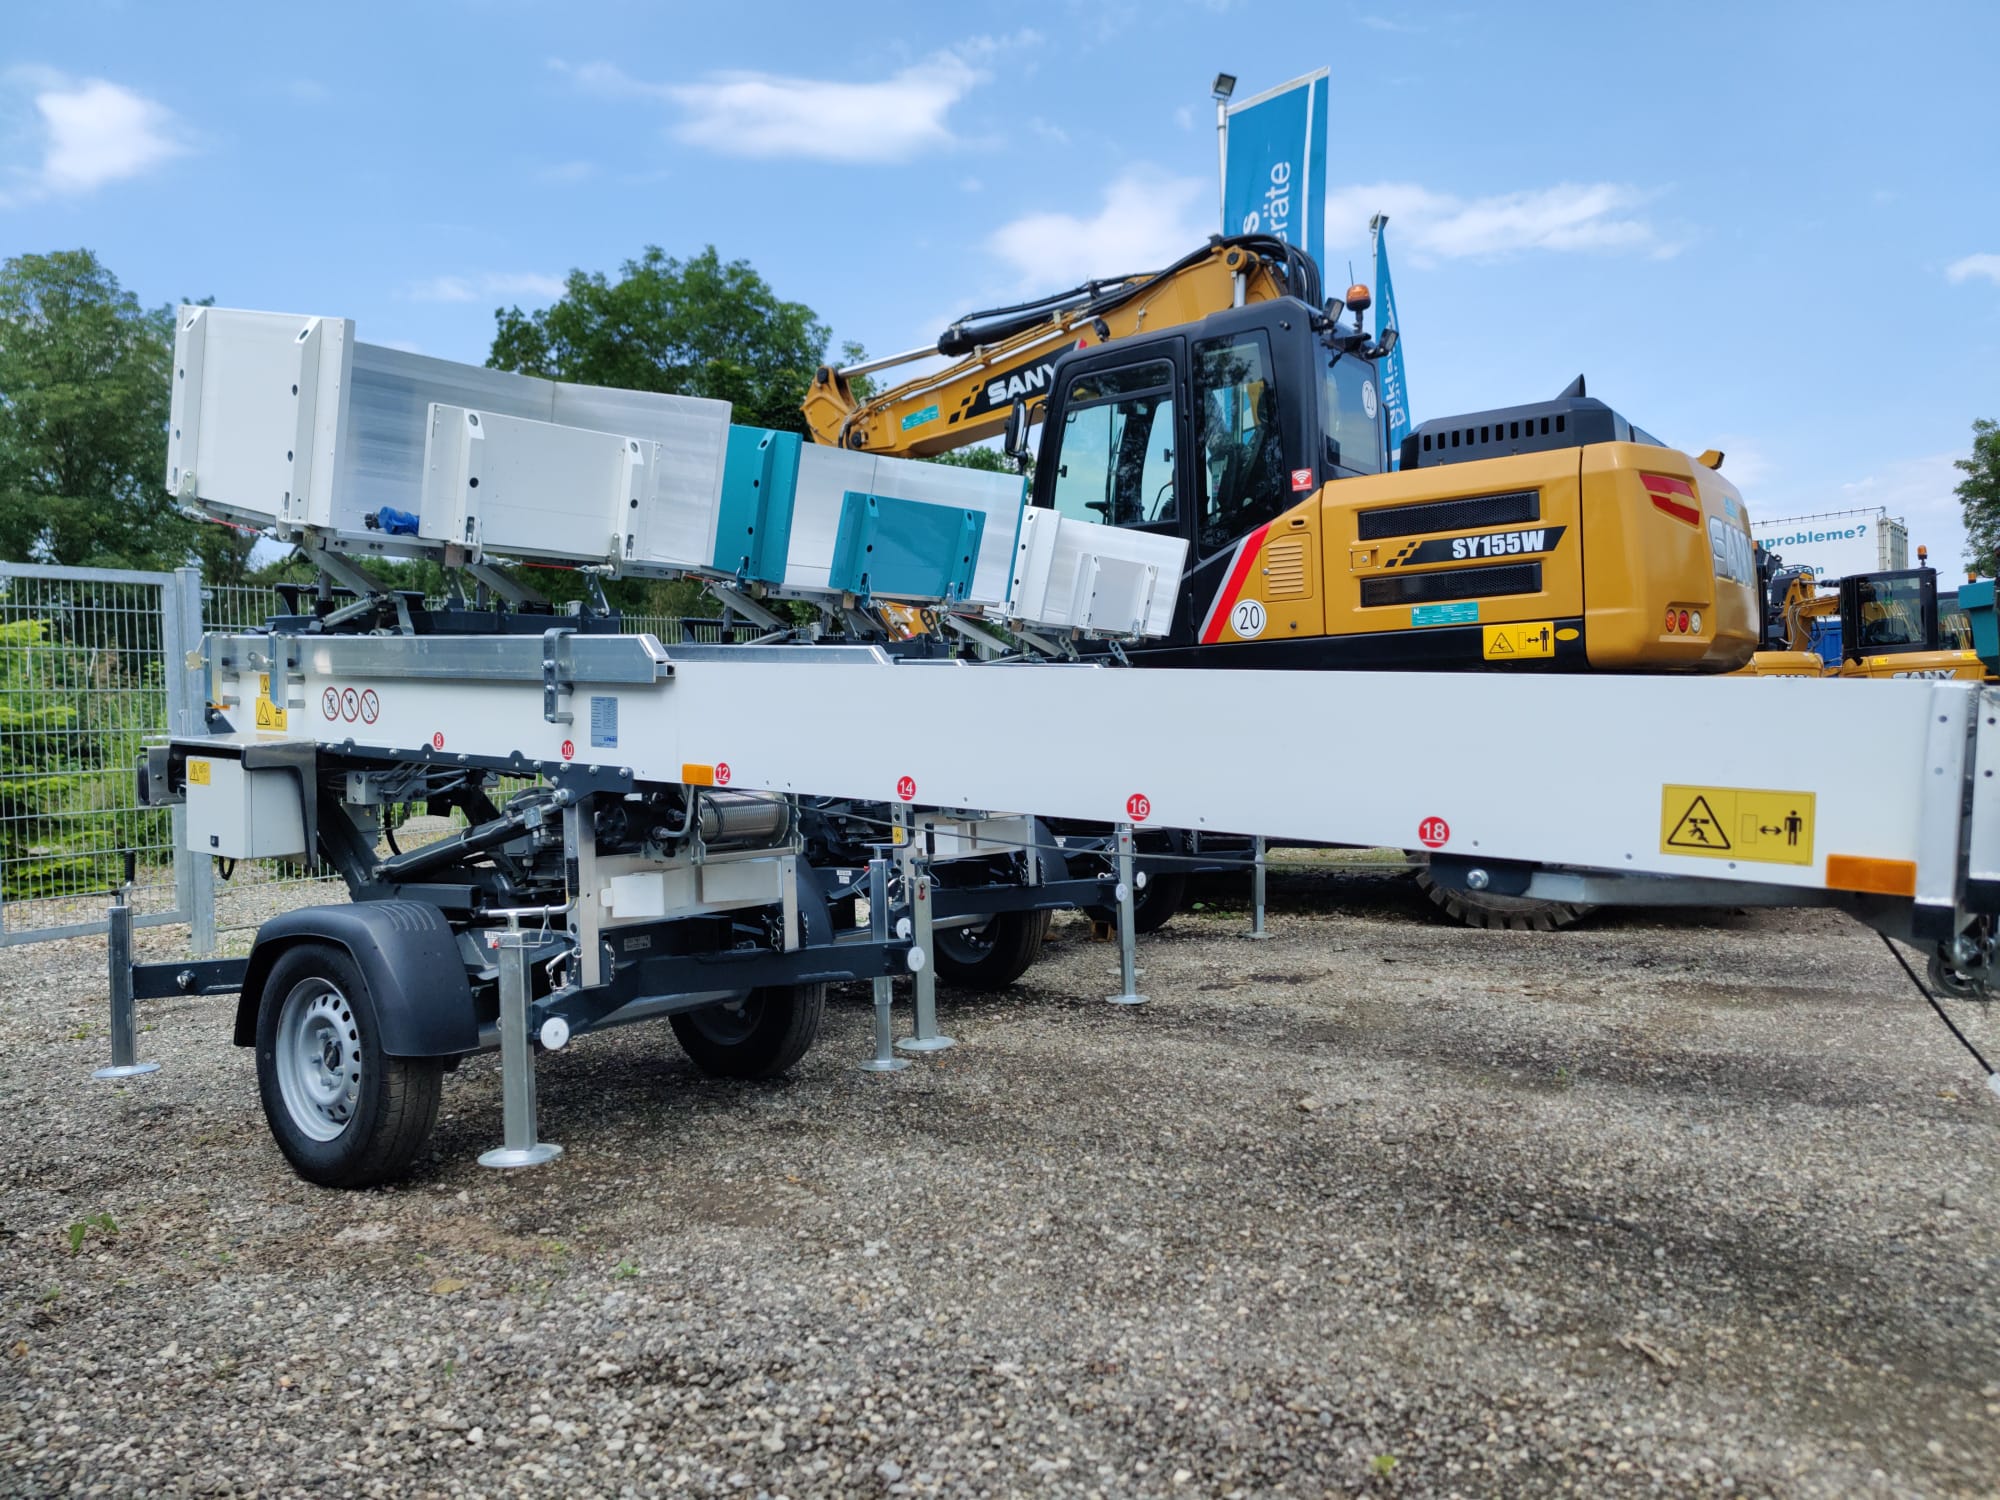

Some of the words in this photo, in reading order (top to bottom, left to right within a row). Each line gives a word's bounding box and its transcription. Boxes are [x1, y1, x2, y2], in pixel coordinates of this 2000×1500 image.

[1452, 530, 1545, 559] SY155W
[1239, 606, 1260, 630] 20
[563, 743, 573, 756] 10
[717, 766, 729, 780] 12
[899, 780, 913, 794] 14
[1130, 798, 1148, 815] 16
[1423, 822, 1446, 841] 18
